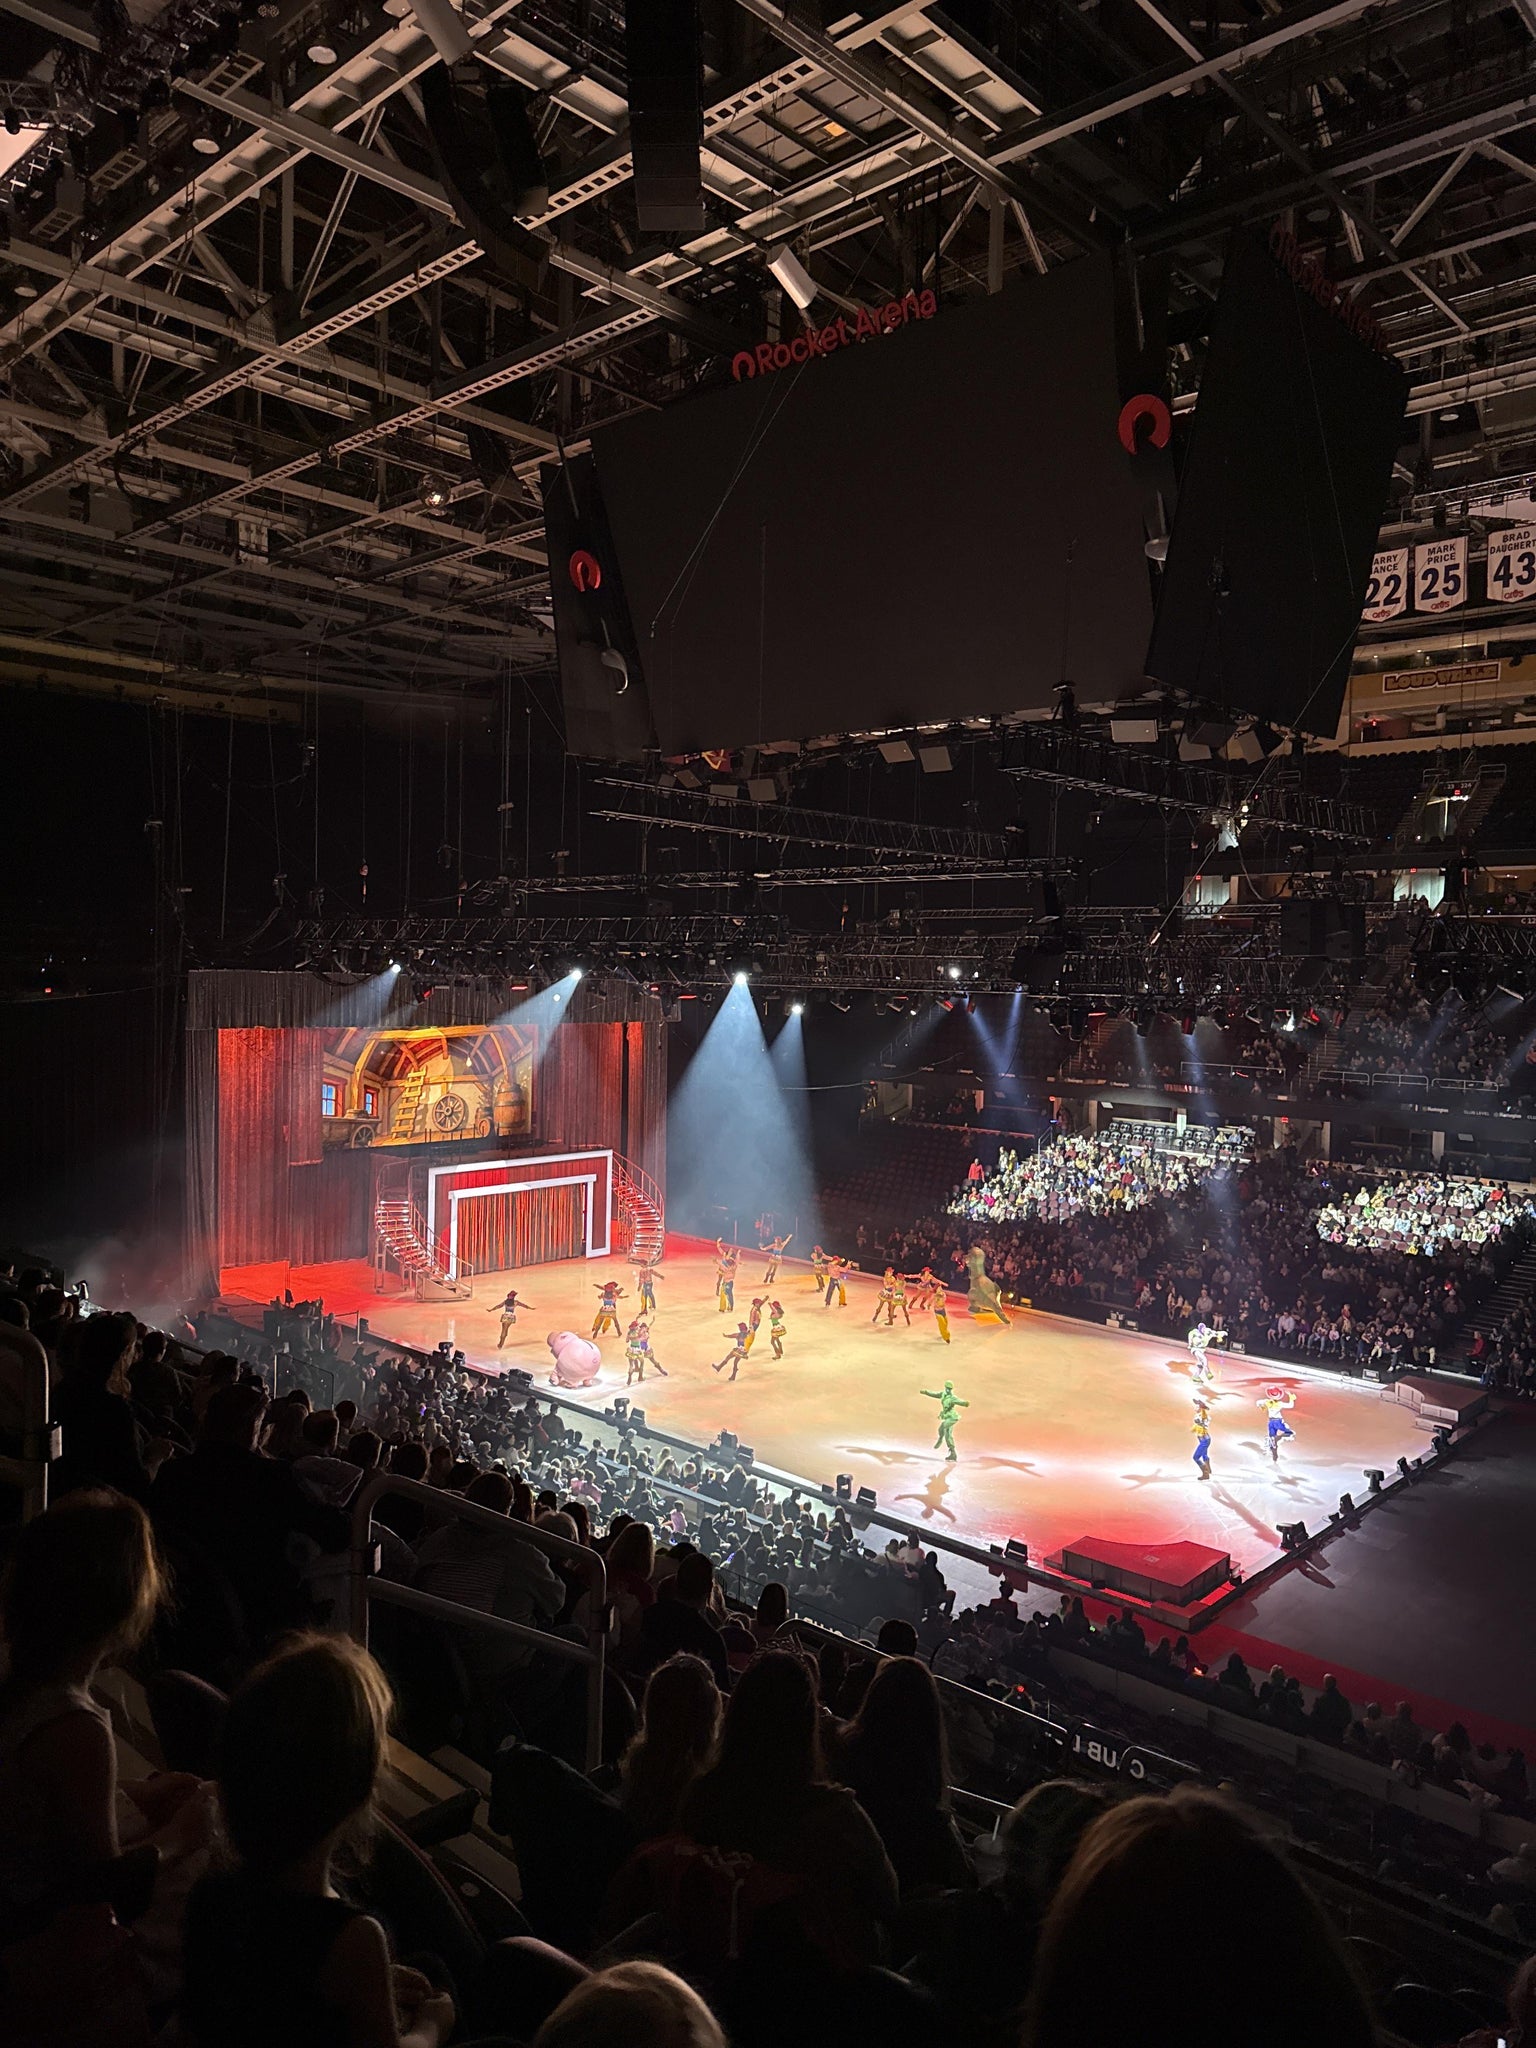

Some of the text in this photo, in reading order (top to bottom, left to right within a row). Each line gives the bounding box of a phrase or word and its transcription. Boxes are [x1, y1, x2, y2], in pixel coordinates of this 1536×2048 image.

[755, 289, 938, 376] Rocket Arena
[1502, 531, 1531, 543] BRAD
[1427, 543, 1456, 556] MARK
[1489, 539, 1536, 555] DAUGHERT
[1373, 554, 1398, 566] ARRY
[1427, 552, 1456, 565] PRICE
[1372, 562, 1398, 575] ANCE
[1493, 551, 1536, 588] 43
[1421, 563, 1461, 600] 25
[1363, 574, 1401, 608] 22
